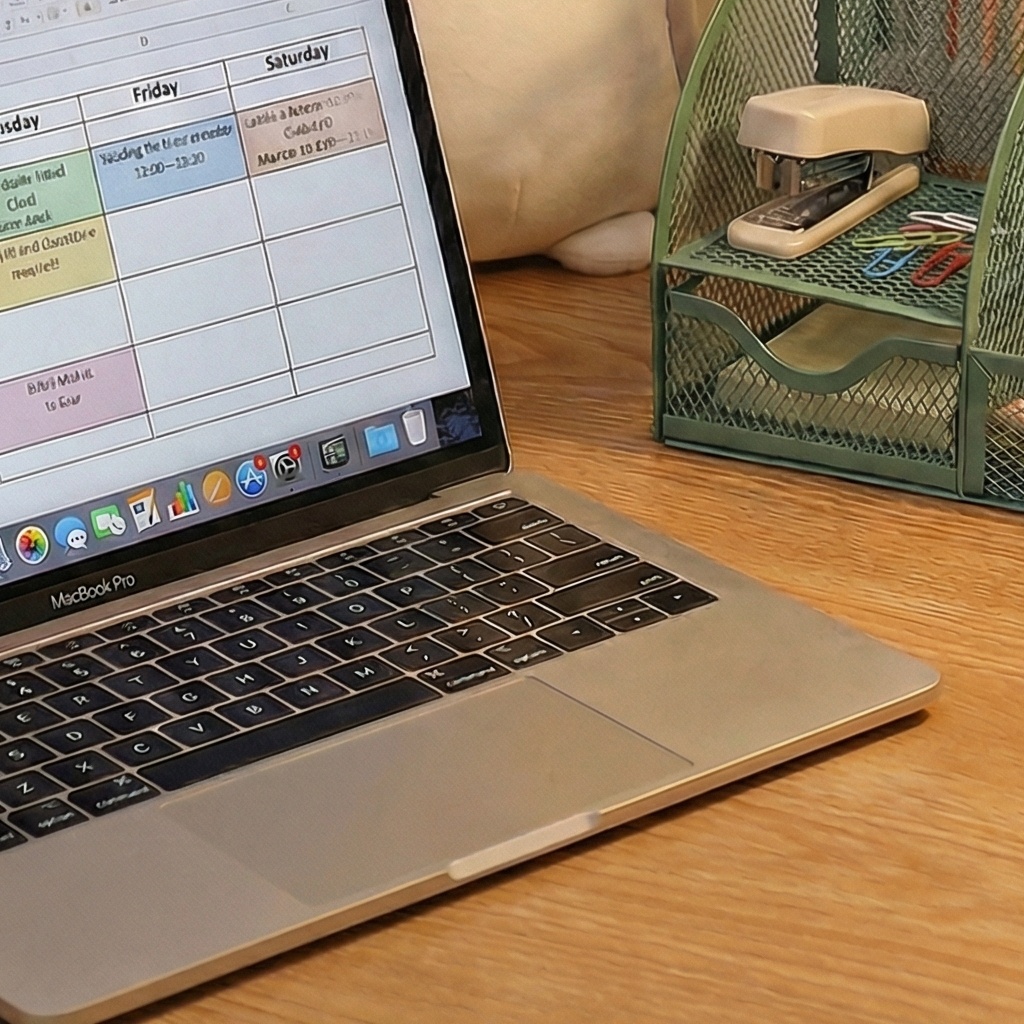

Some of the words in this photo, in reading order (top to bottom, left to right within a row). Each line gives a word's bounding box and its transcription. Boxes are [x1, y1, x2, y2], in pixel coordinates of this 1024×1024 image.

[265, 45, 328, 71] Saturday
[133, 81, 178, 102] Friday
[51, 580, 111, 610] MacBook
[113, 574, 135, 592] Pro
[349, 603, 364, 613] O
[396, 619, 416, 628] L
[239, 639, 257, 649] U
[185, 657, 200, 667] Y
[188, 722, 204, 733] V
[66, 731, 82, 741] D
[133, 742, 150, 753] C
[75, 761, 94, 773] X
[16, 781, 35, 794] Z
